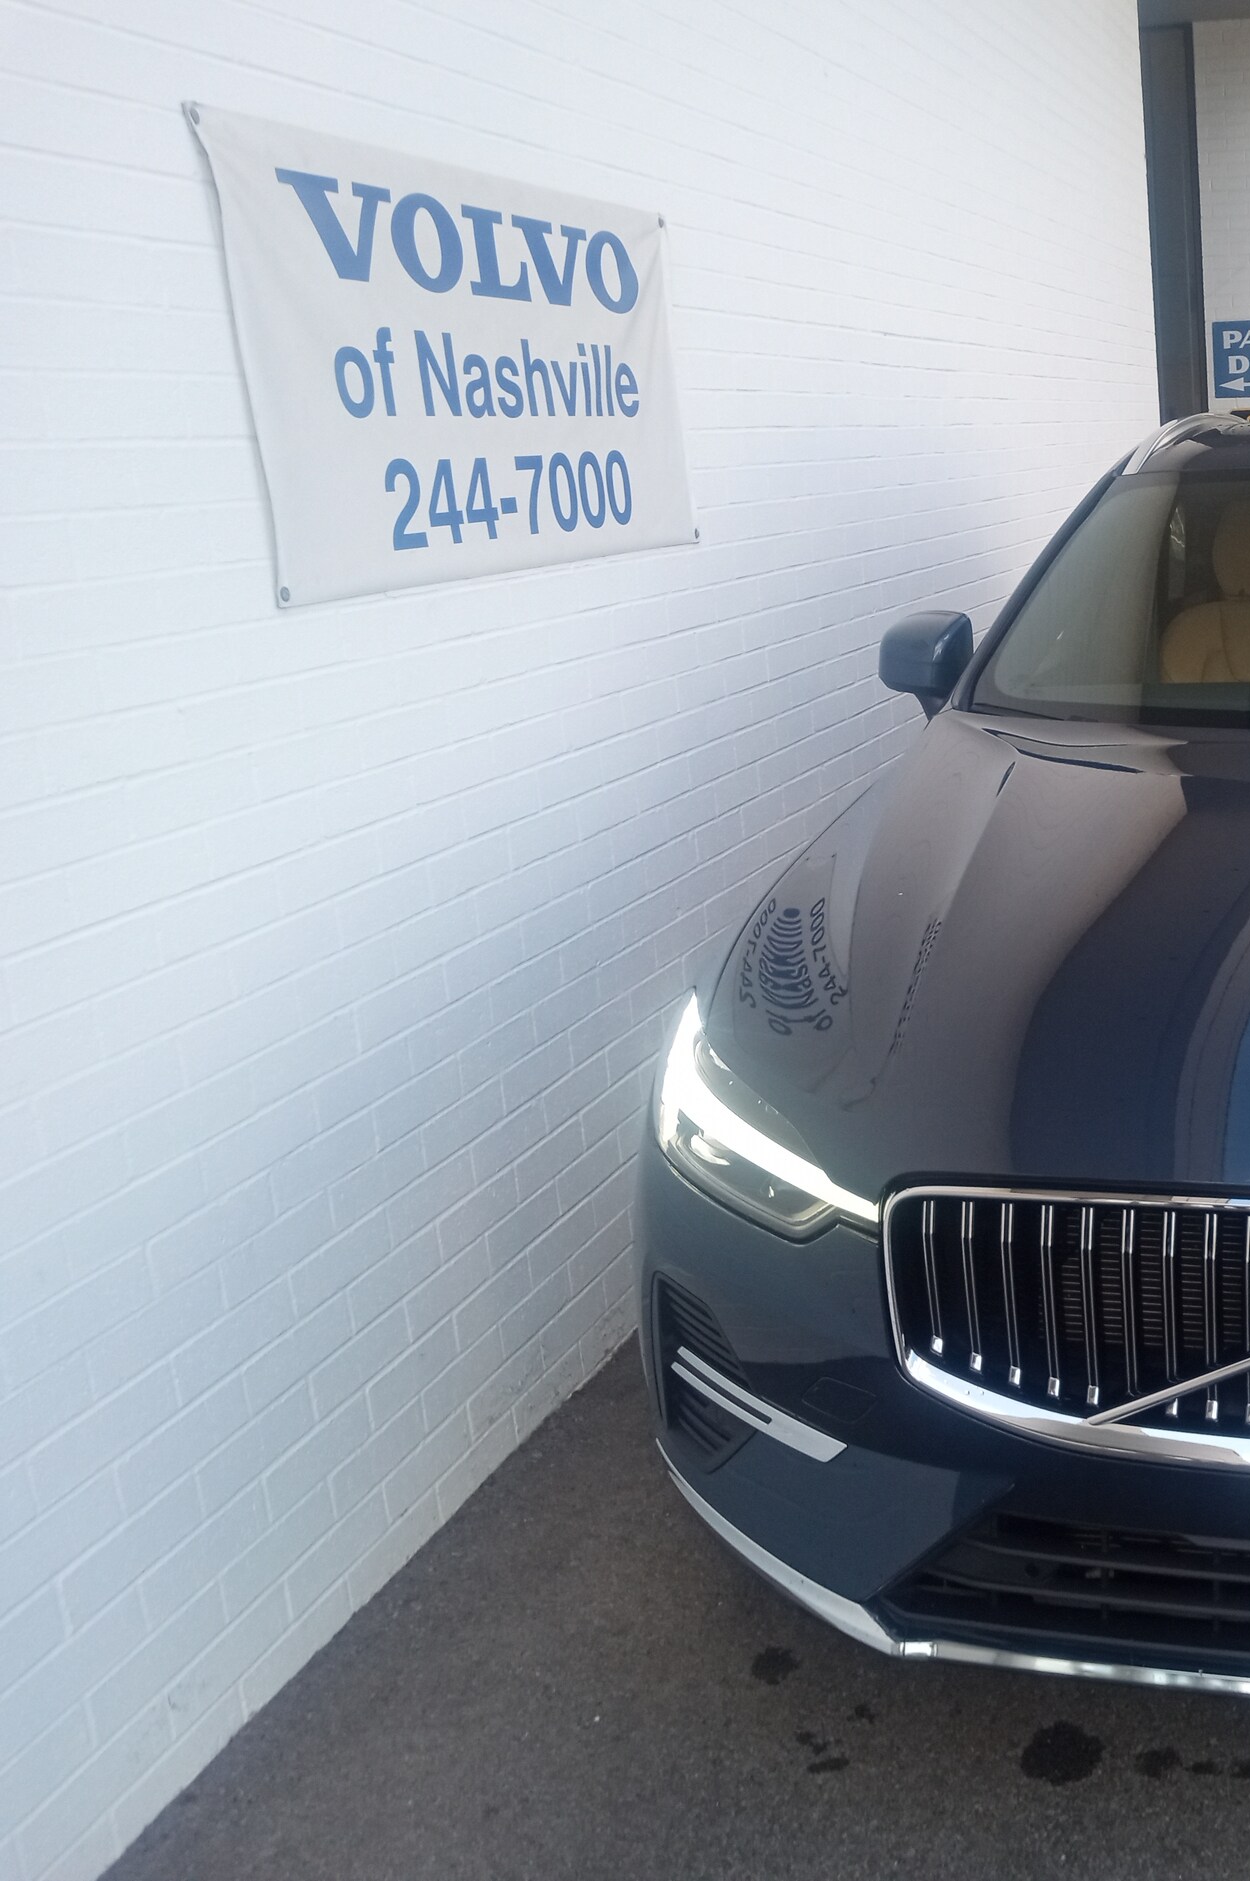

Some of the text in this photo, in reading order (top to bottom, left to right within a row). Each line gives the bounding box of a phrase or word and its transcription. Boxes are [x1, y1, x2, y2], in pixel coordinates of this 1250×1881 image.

[274, 167, 640, 314] VOLVO
[334, 326, 640, 419] of Nashville
[384, 450, 633, 551] 244-7000
